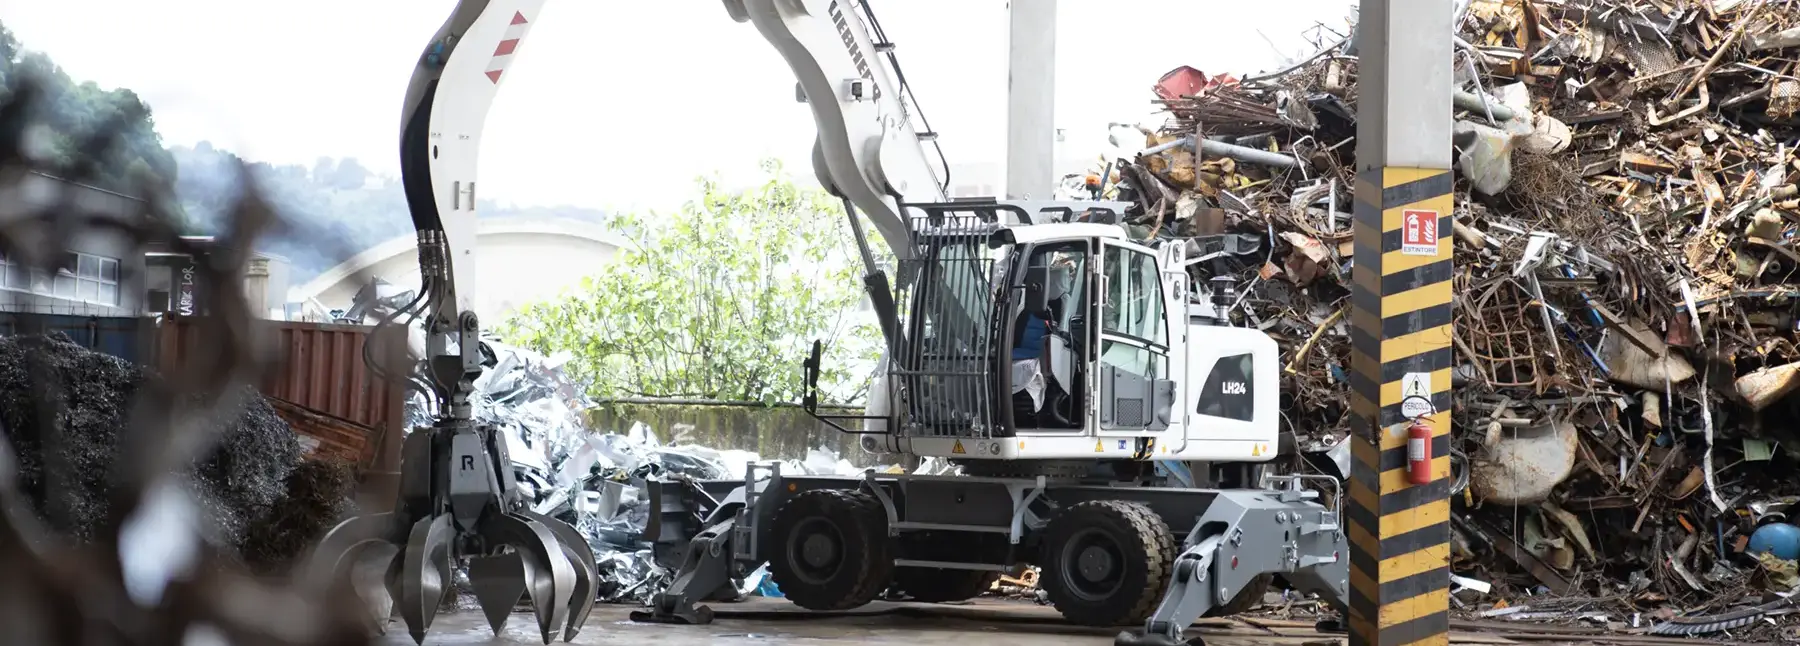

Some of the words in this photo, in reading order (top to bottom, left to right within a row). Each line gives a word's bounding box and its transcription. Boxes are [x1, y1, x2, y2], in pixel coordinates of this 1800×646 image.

[1404, 246, 1436, 254] ESTINTORE
[1222, 381, 1246, 395] LH24
[1404, 402, 1429, 411] PERICOLO
